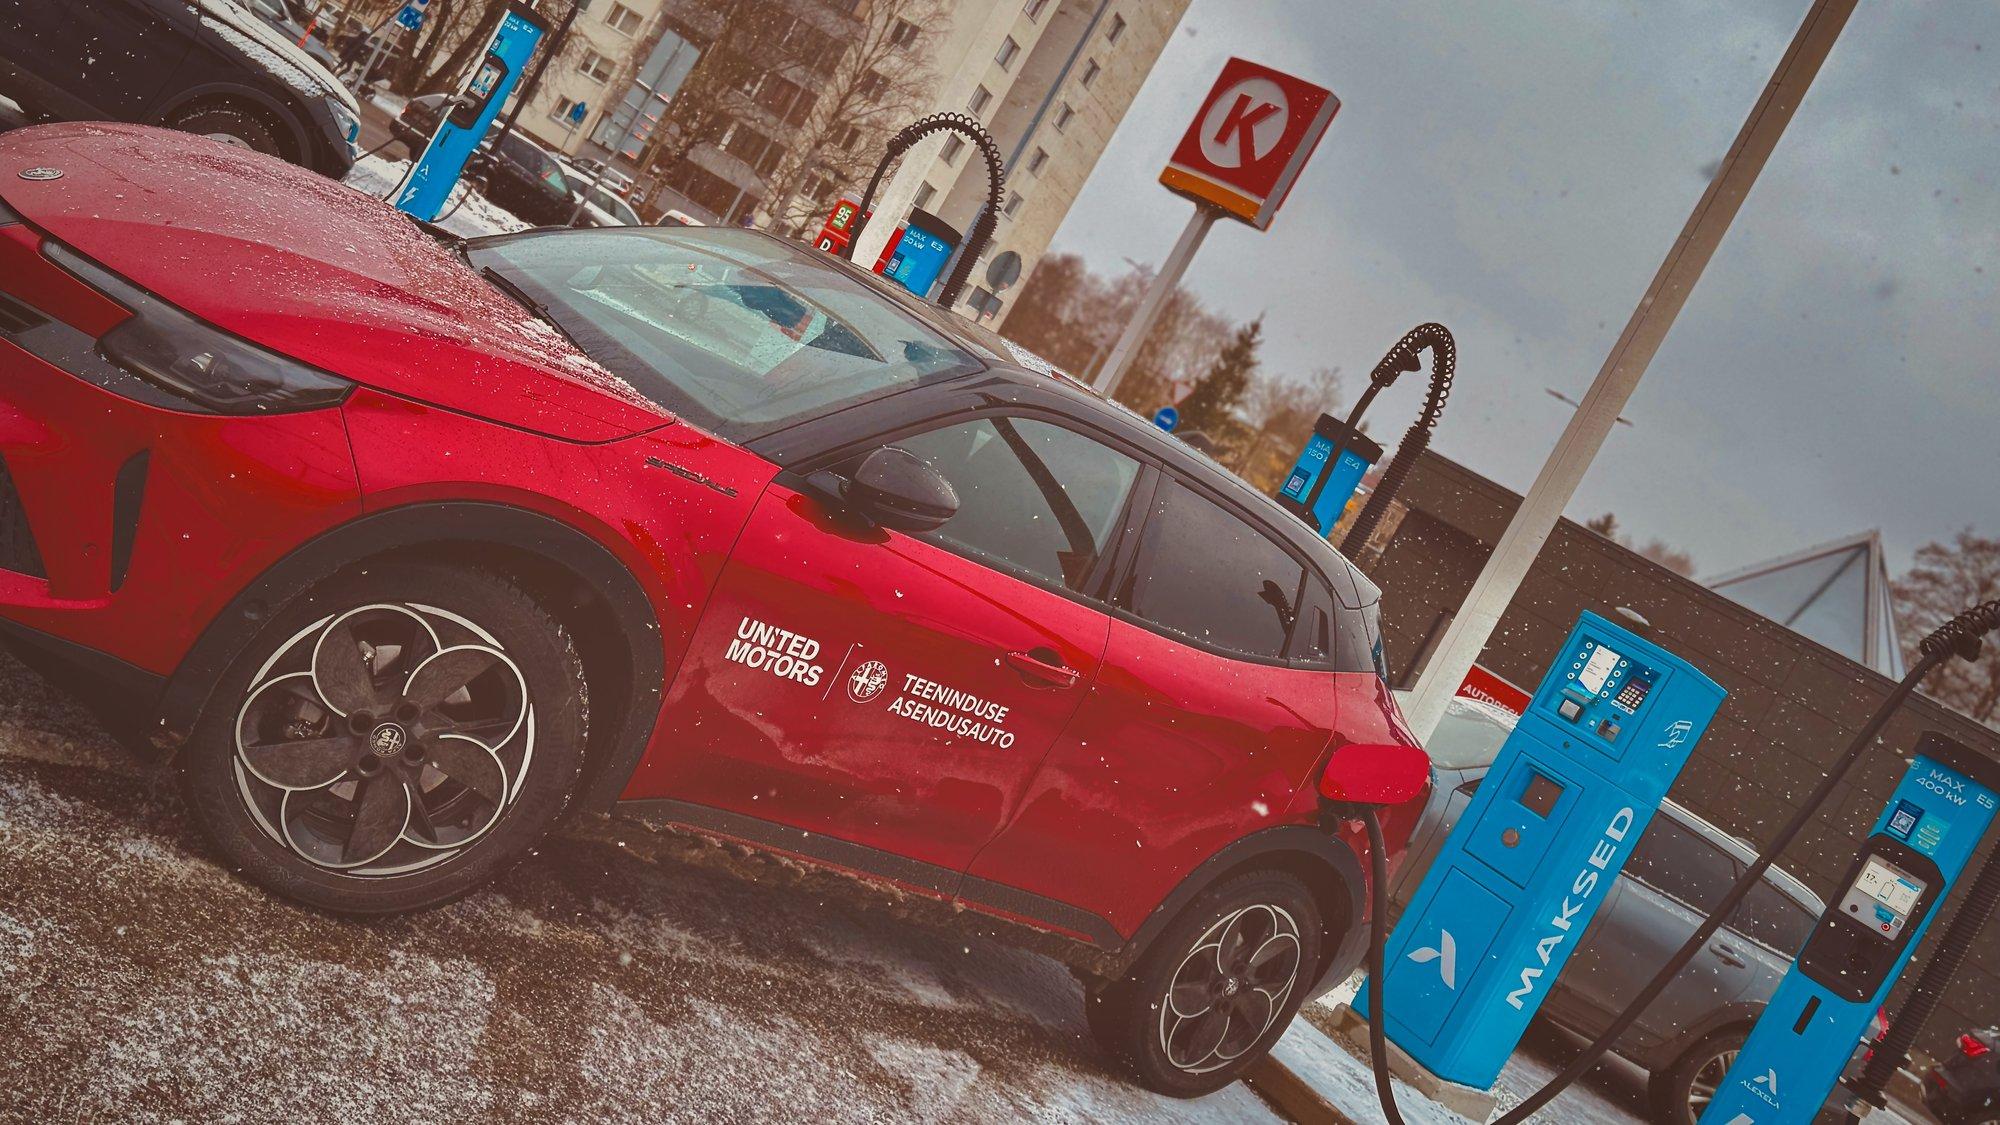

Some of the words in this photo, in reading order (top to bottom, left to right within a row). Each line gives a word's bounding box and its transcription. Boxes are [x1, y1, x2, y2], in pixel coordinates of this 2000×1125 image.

[1213, 93, 1283, 169] K
[836, 207, 852, 222] 95
[819, 238, 831, 251] D
[903, 235, 916, 245] 50
[913, 241, 925, 250] kW
[909, 229, 926, 242] MAX
[930, 241, 944, 252] E3
[1307, 448, 1324, 460] 150
[1315, 441, 1331, 453] MA
[1344, 457, 1360, 470] E4
[736, 616, 821, 661] UNITED
[724, 639, 824, 687] MOTORS
[902, 673, 1010, 724] TEENINDUSE
[887, 696, 1016, 750] ASENDUSAUTO
[1929, 769, 1966, 793] MAX
[1915, 777, 1944, 795] 400
[1945, 793, 1967, 807] kW
[1976, 794, 1995, 809] E5
[1505, 806, 1634, 1010] MAKSED
[1740, 1080, 1780, 1109] ALEXELA
